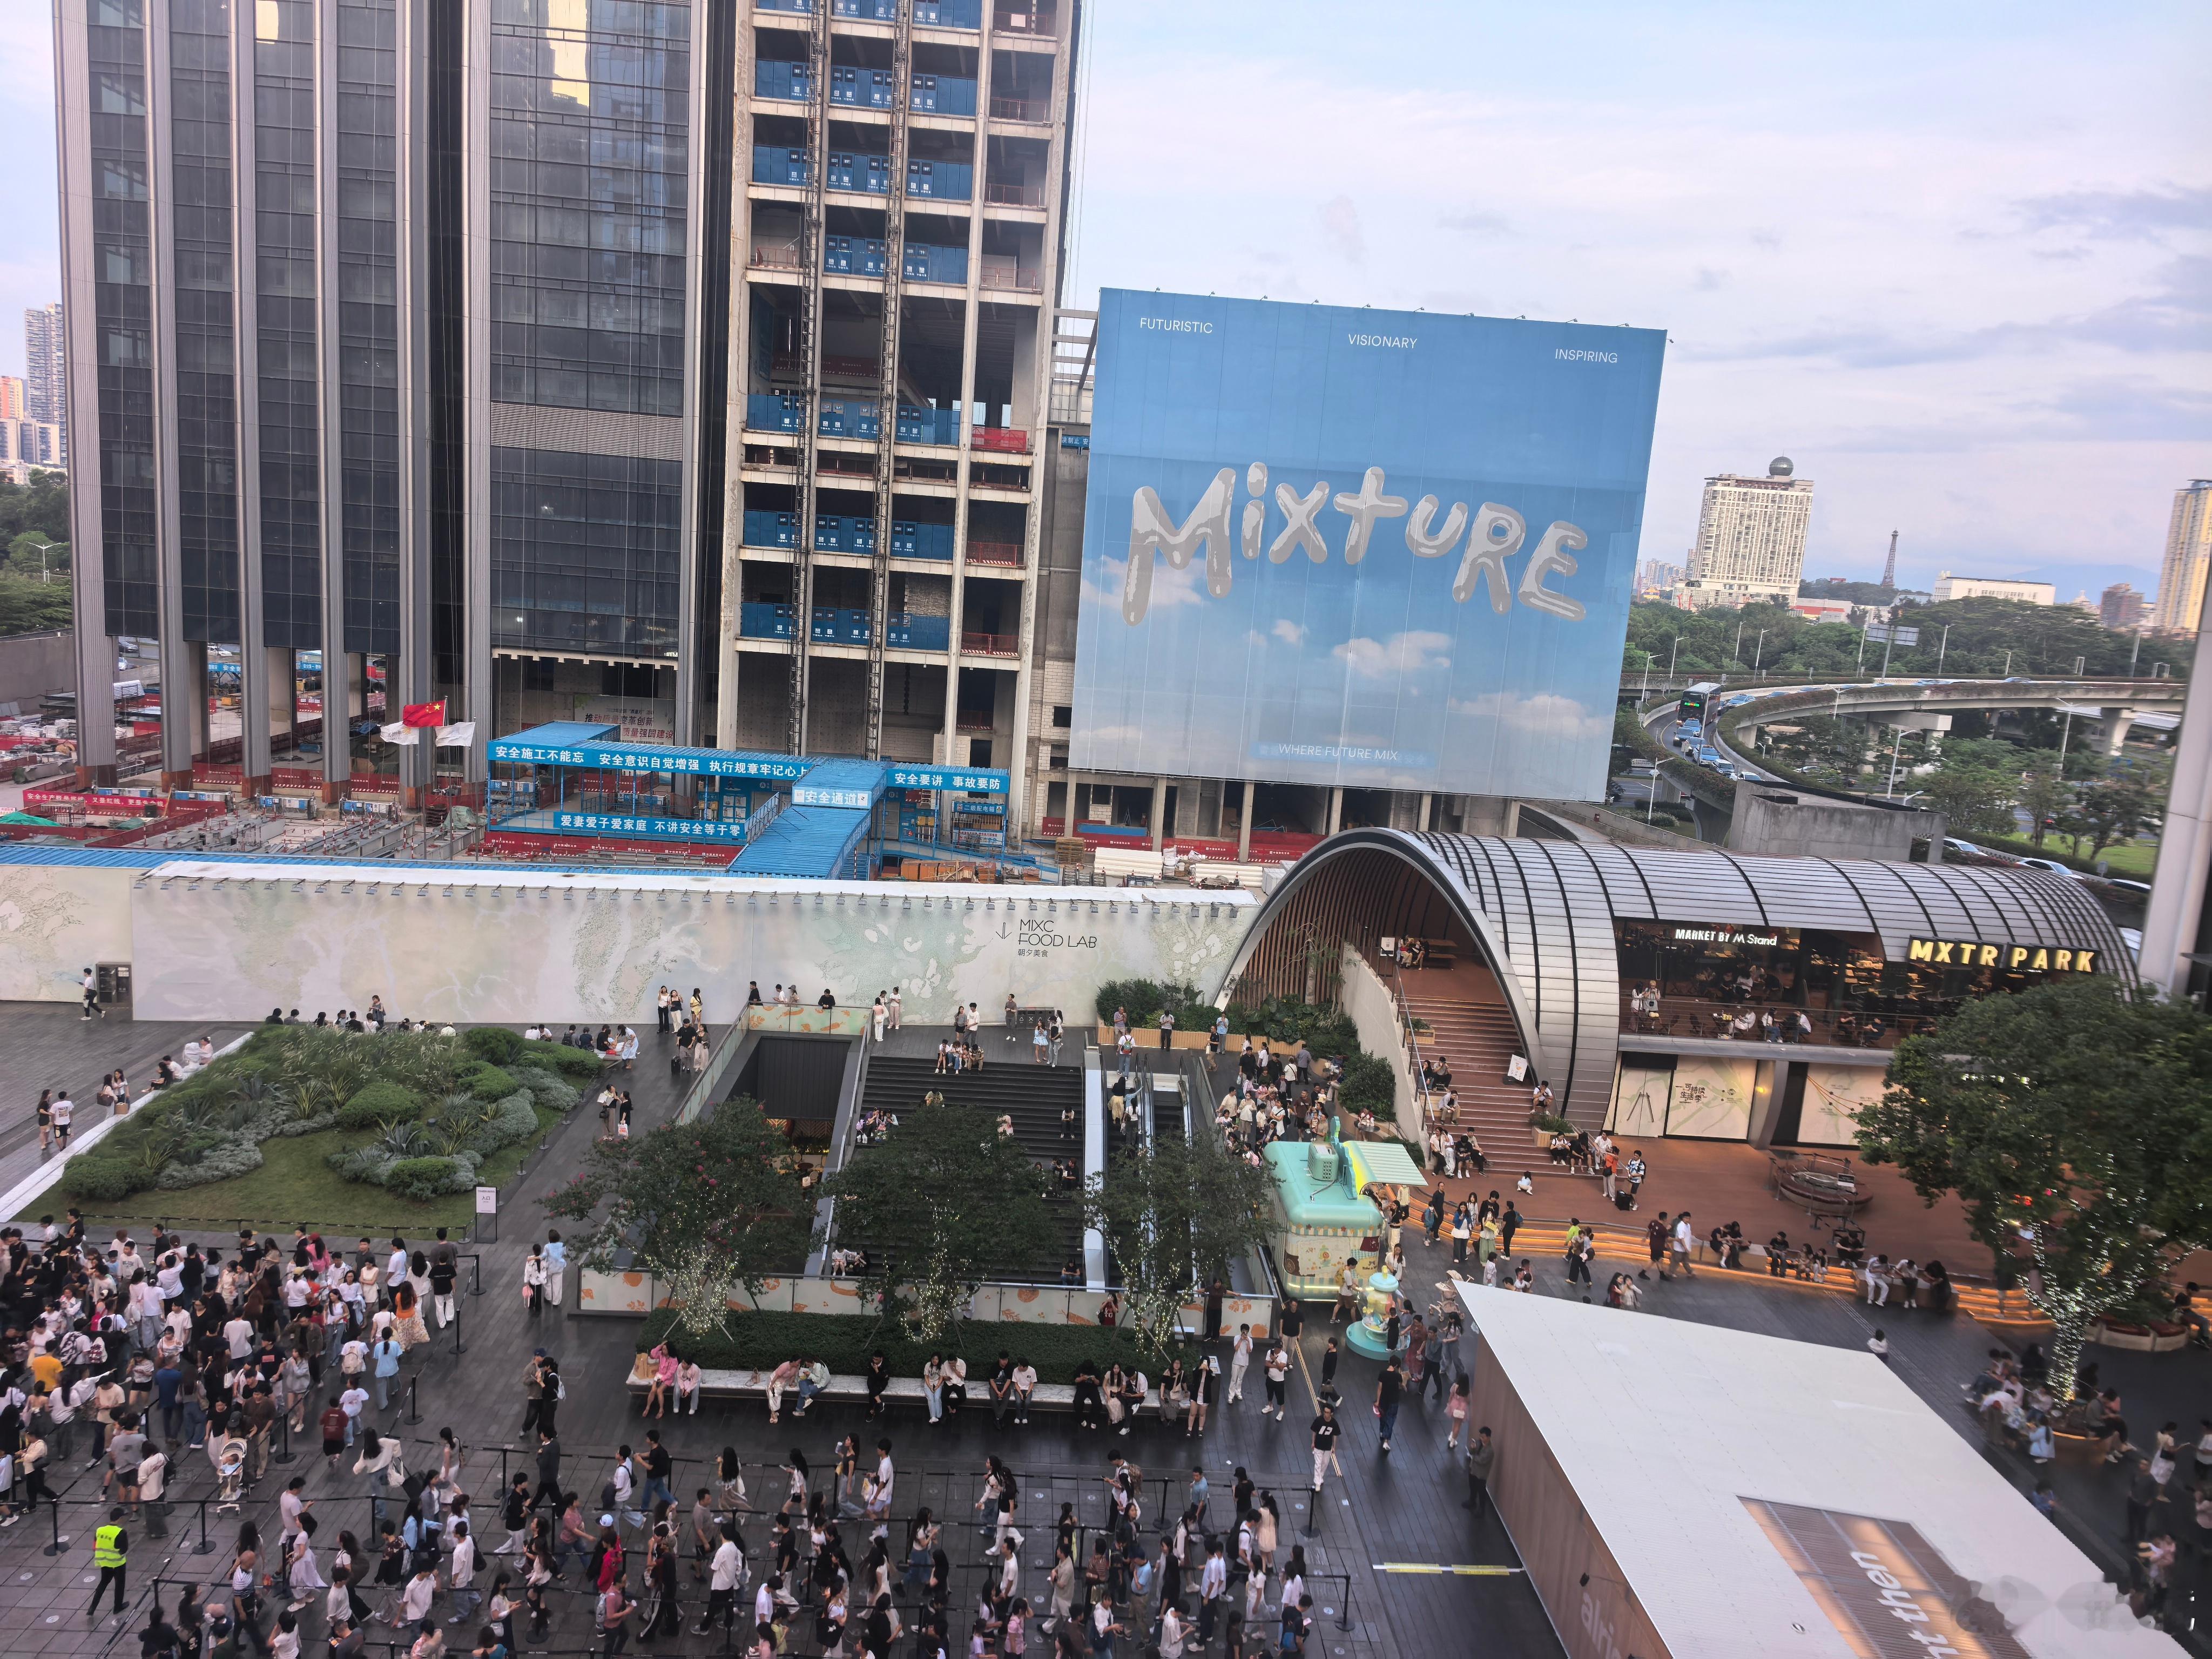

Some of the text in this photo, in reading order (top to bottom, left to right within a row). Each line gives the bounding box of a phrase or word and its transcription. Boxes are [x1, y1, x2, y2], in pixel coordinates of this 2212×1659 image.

[1139, 318, 1213, 334] FUTURISTIC
[1347, 334, 1418, 348] VISIONARY
[1554, 348, 1618, 363] INSPIRING
[1278, 743, 1398, 761] WHERE FUTURE MIX
[495, 746, 809, 777] 安全施工不能忘 安全意识自觉增强 执行规章牢记心上
[895, 772, 943, 787] 安全要讲
[952, 775, 1001, 790] 事故要防
[805, 790, 858, 805] 安全通道
[561, 814, 740, 837] 爱妻爱子爱家庭 不讲安全等于零
[1020, 919, 1054, 932] MIXC
[1018, 933, 1097, 948] FOOD LAB
[1675, 929, 1716, 941] MARKET
[1718, 932, 1731, 942] BY
[1746, 934, 1777, 946] Stand
[1018, 949, 1048, 957] 朝夕美食
[1910, 939, 2095, 972] MXTR PARK
[1850, 1551, 1930, 1623] then
